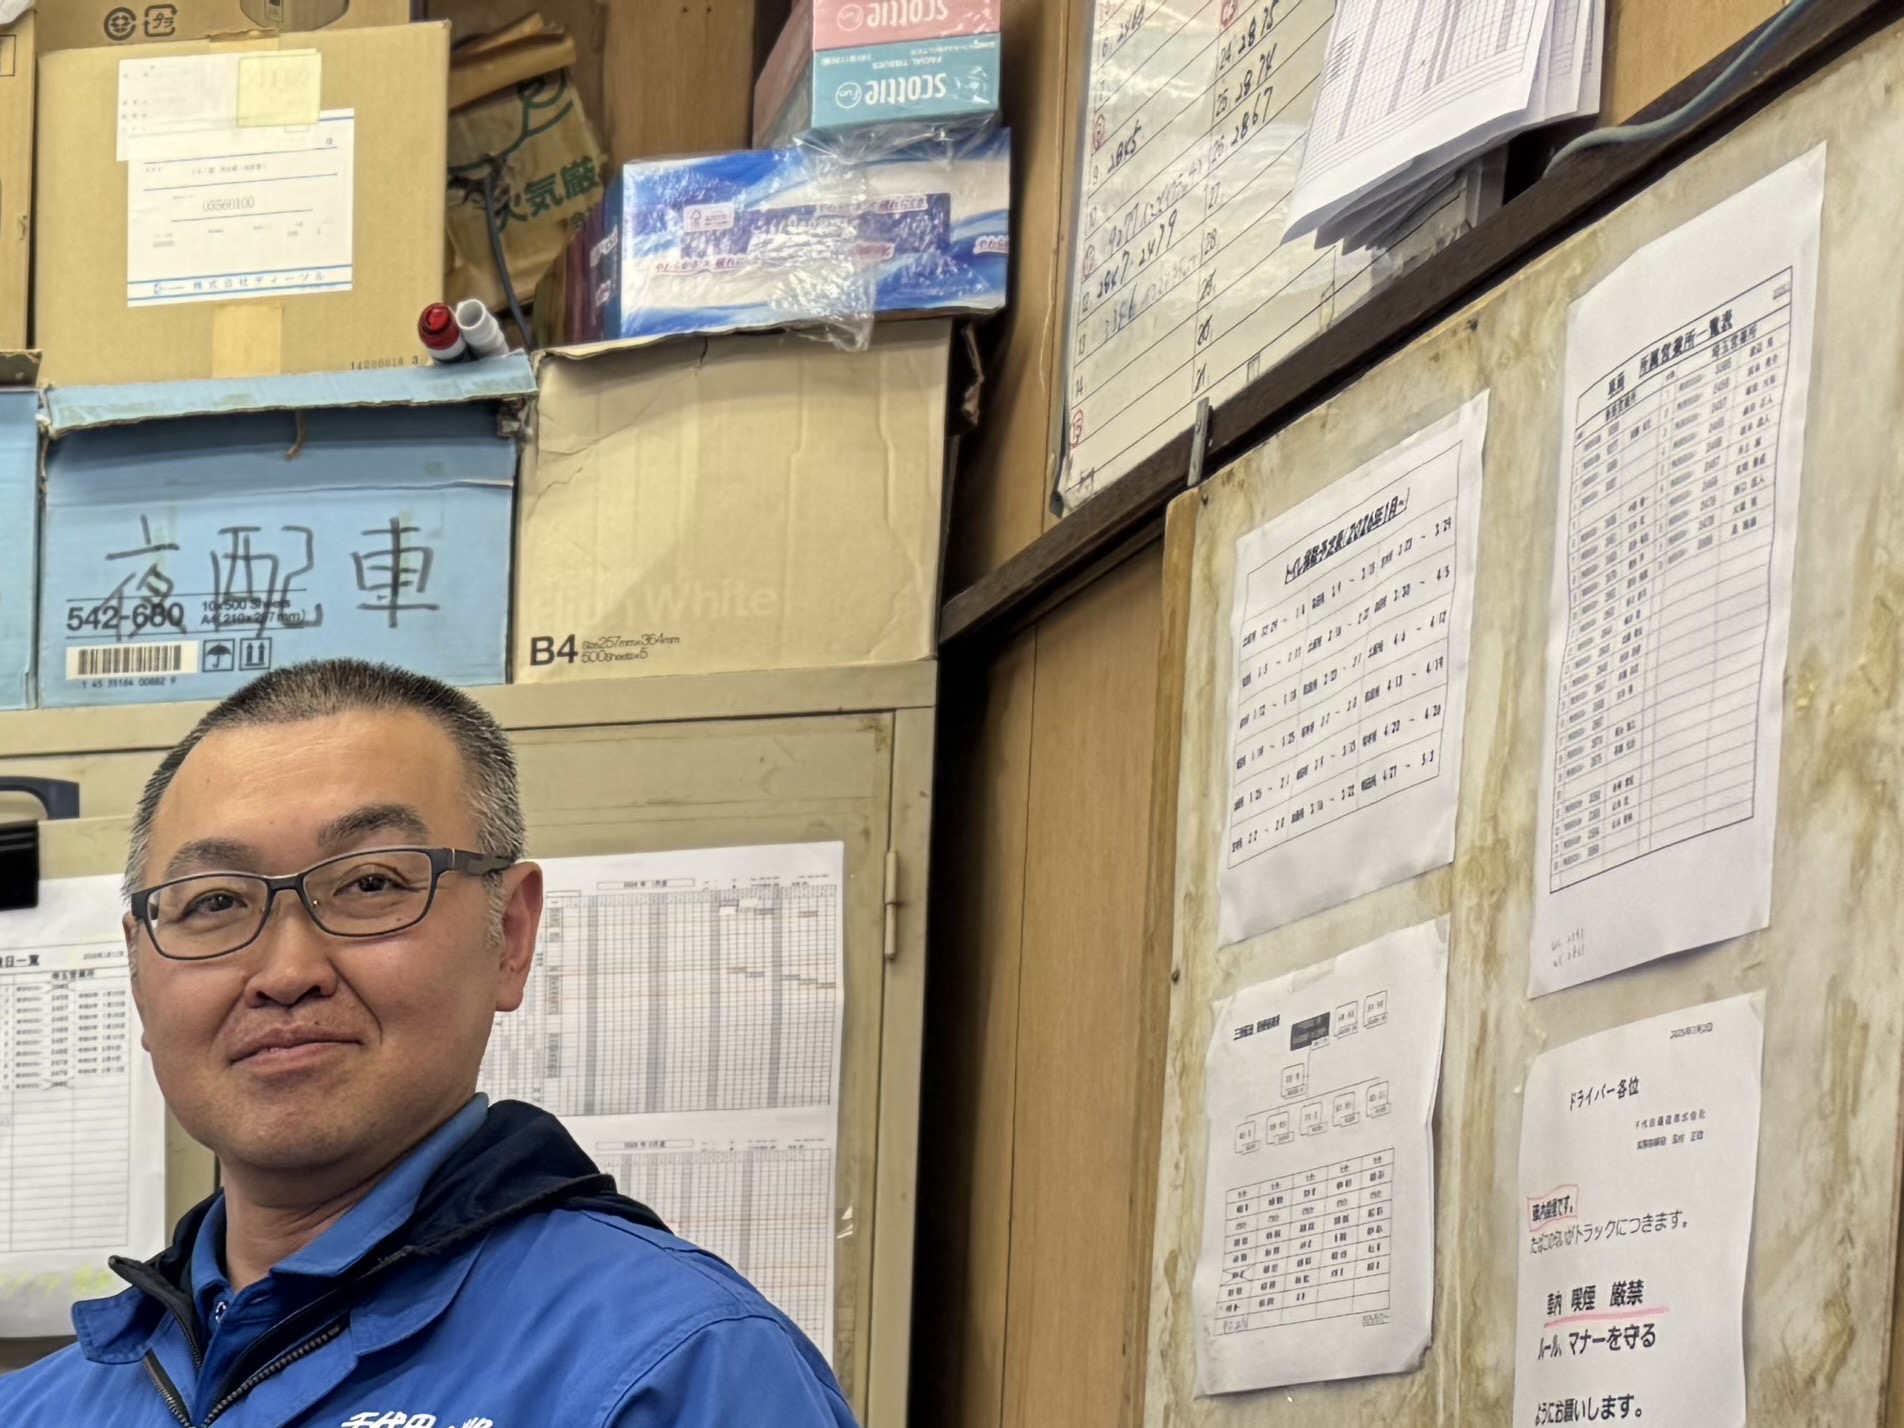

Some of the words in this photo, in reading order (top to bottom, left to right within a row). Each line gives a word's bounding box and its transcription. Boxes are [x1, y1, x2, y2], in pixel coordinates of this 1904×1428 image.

[865, 72, 947, 104] scottie
[529, 634, 579, 667] B4
[1569, 1075, 1639, 1112] ドライバー各位
[1609, 1279, 1645, 1308] 厳禁
